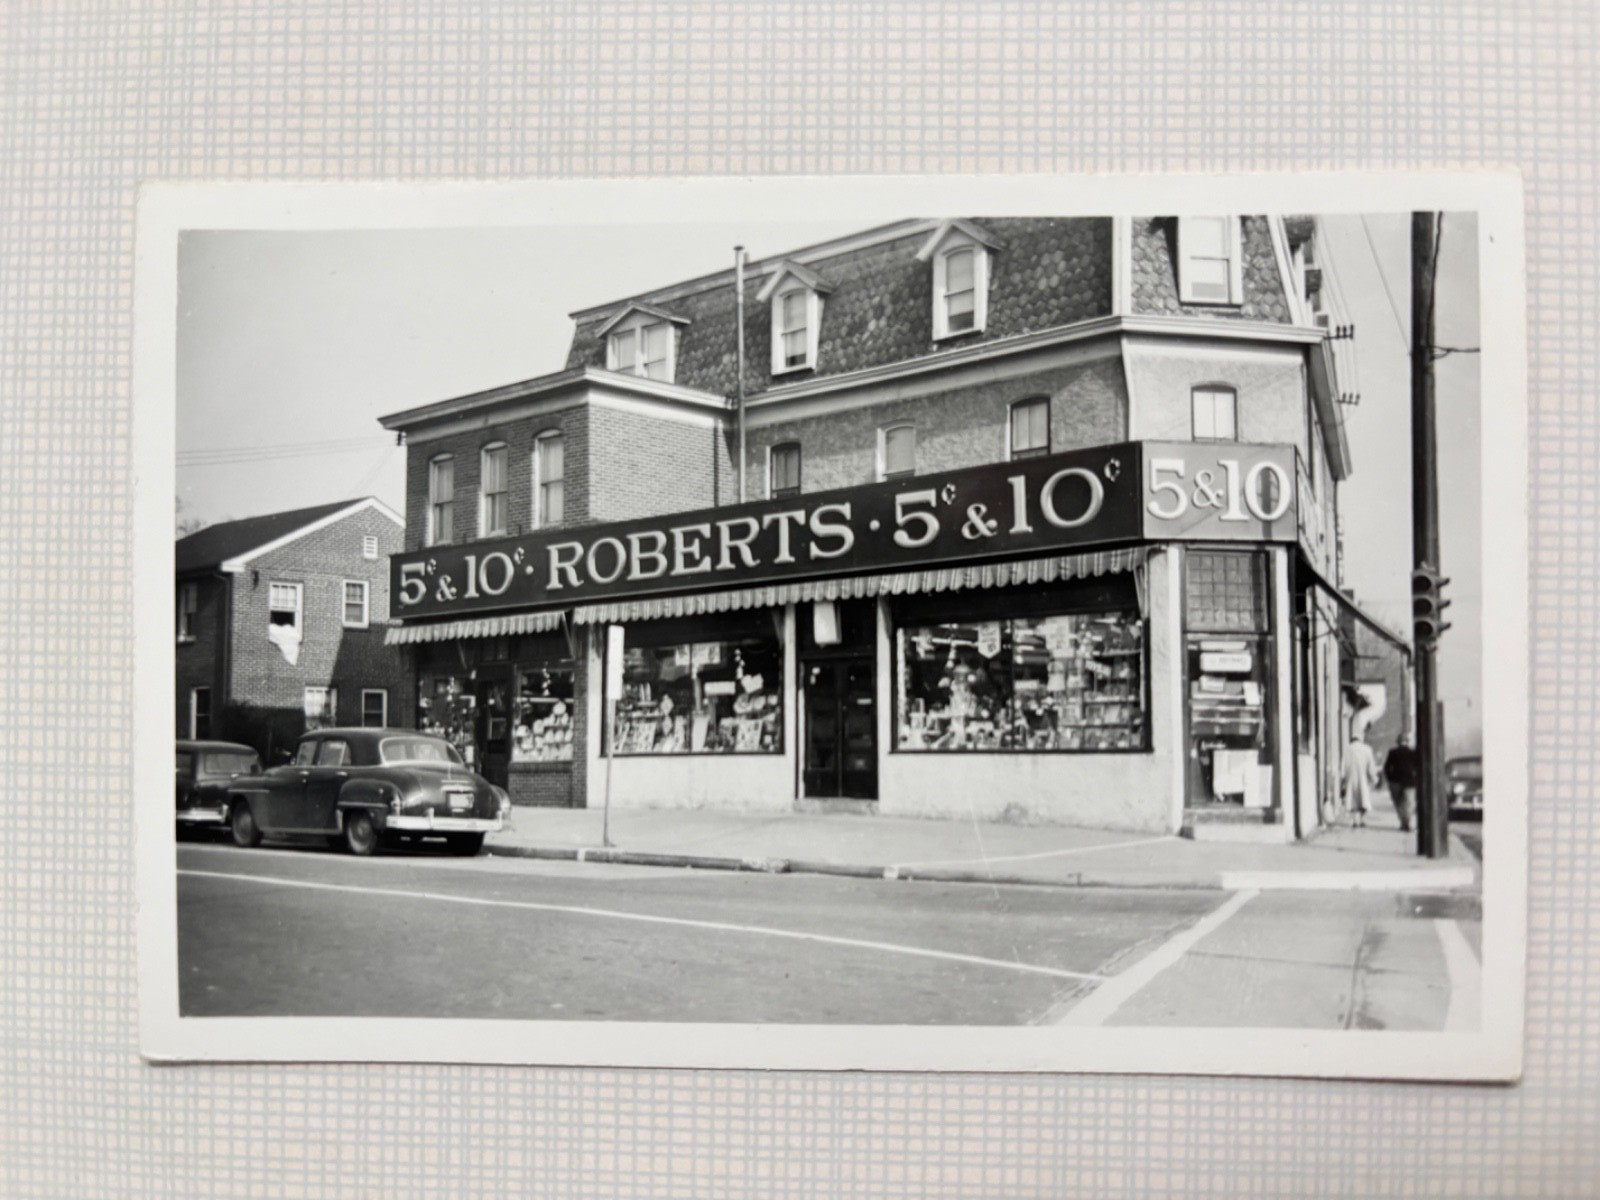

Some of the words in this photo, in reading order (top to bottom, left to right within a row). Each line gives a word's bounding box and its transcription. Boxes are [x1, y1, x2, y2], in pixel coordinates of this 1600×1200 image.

[435, 574, 457, 602] &
[546, 502, 855, 591] ROBERTS
[961, 503, 998, 540] &
